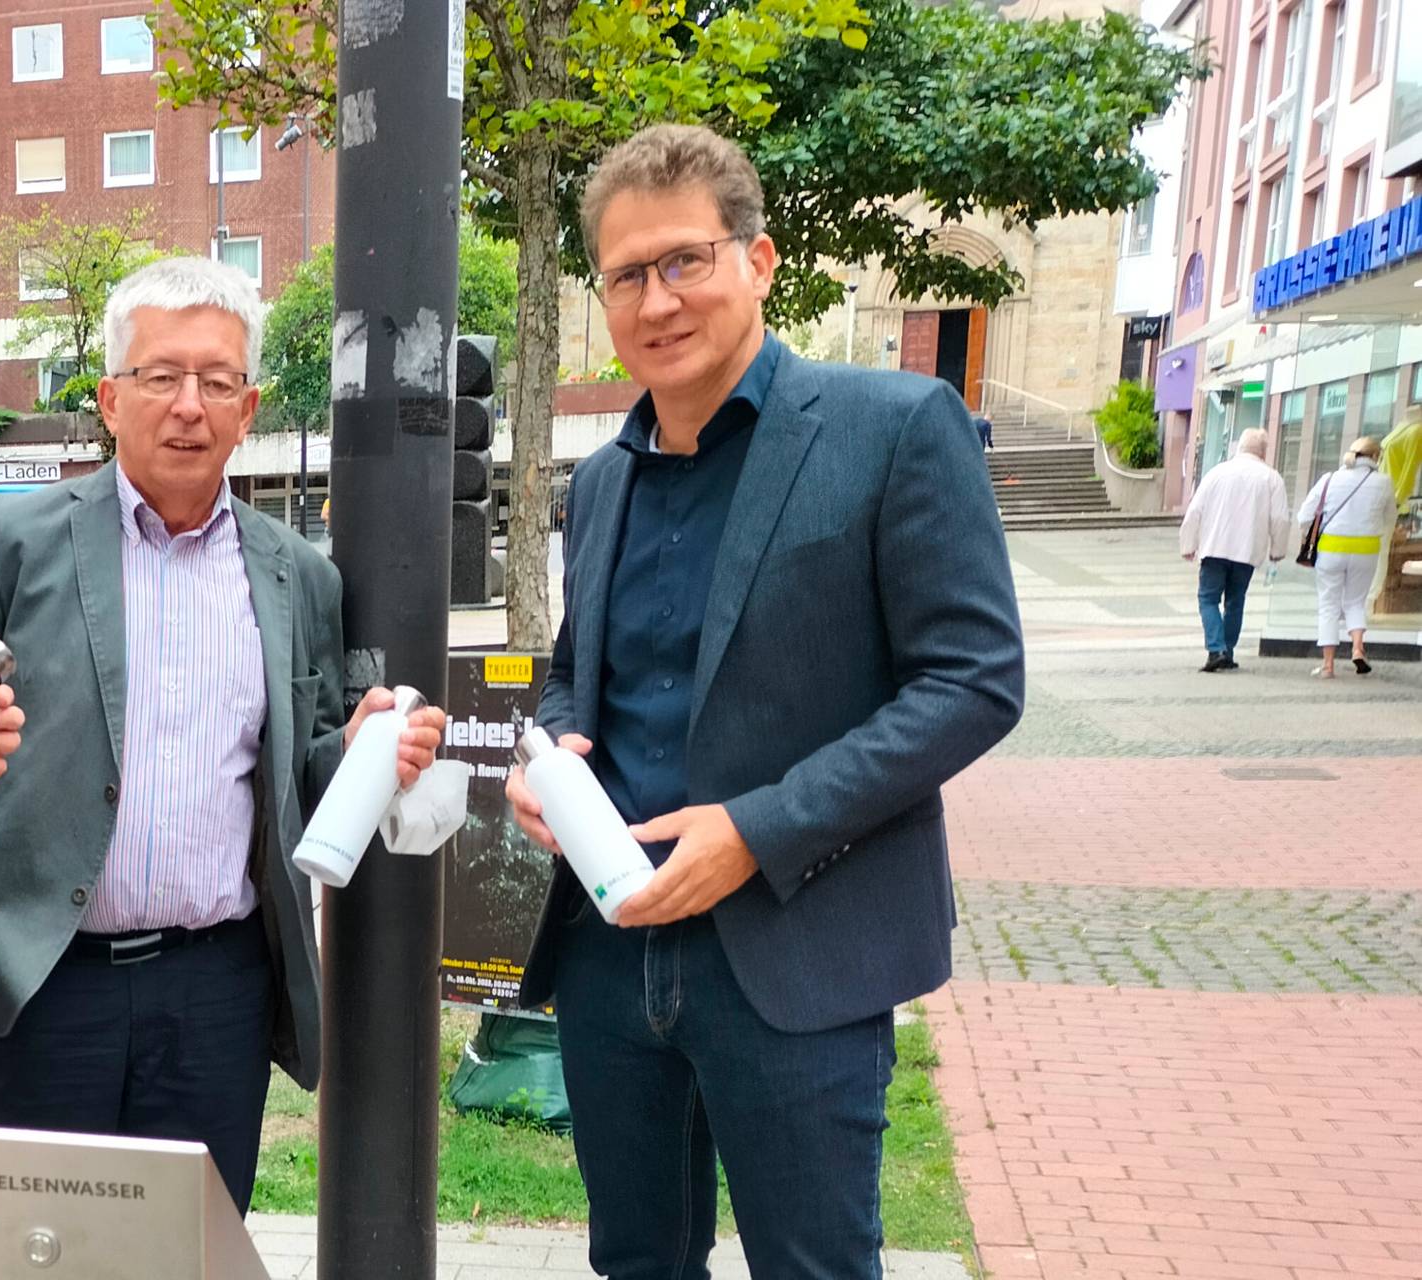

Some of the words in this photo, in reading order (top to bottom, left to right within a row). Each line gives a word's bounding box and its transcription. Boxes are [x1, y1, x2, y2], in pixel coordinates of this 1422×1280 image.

[1132, 320, 1159, 336] sky
[487, 663, 530, 677] THEATER
[445, 714, 516, 748] iebes
